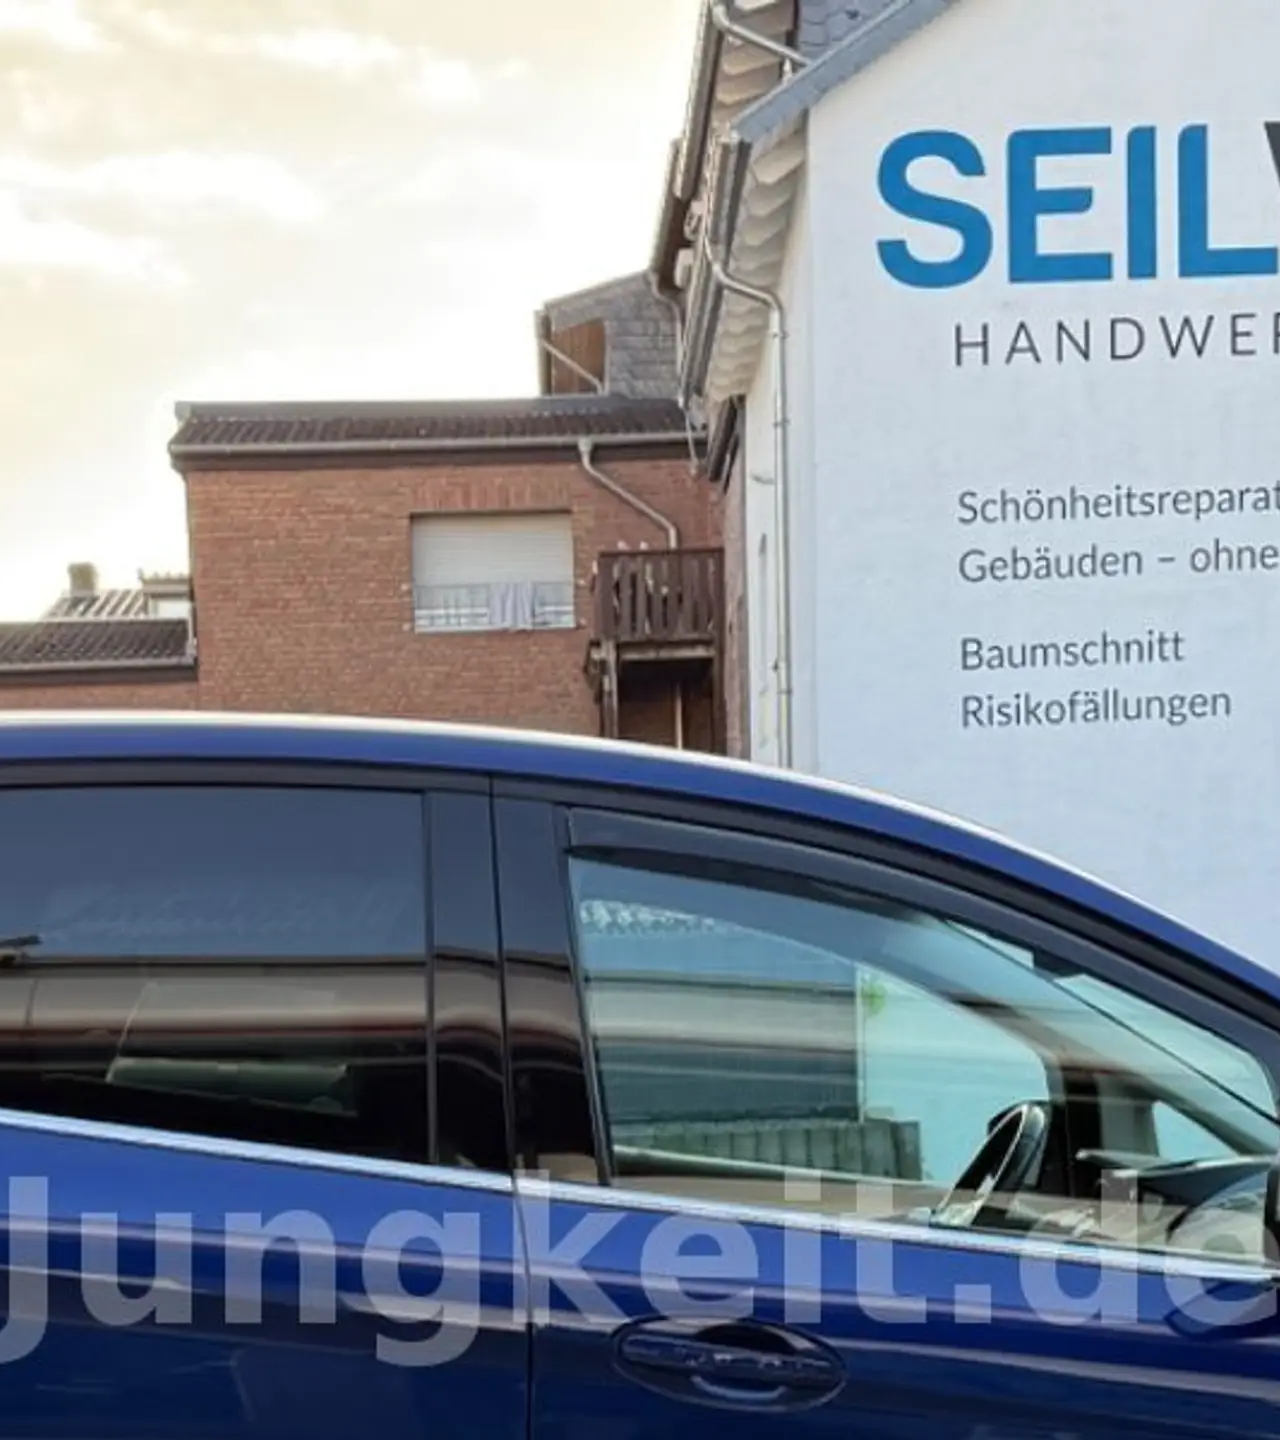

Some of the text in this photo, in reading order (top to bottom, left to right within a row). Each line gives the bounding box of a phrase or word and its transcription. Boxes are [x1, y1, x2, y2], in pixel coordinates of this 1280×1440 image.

[957, 542, 1145, 585] Gebäuden
[1188, 537, 1280, 575] ohne
[959, 629, 1186, 673] Baumschnitt
[960, 686, 1233, 731] Risikofällungen
